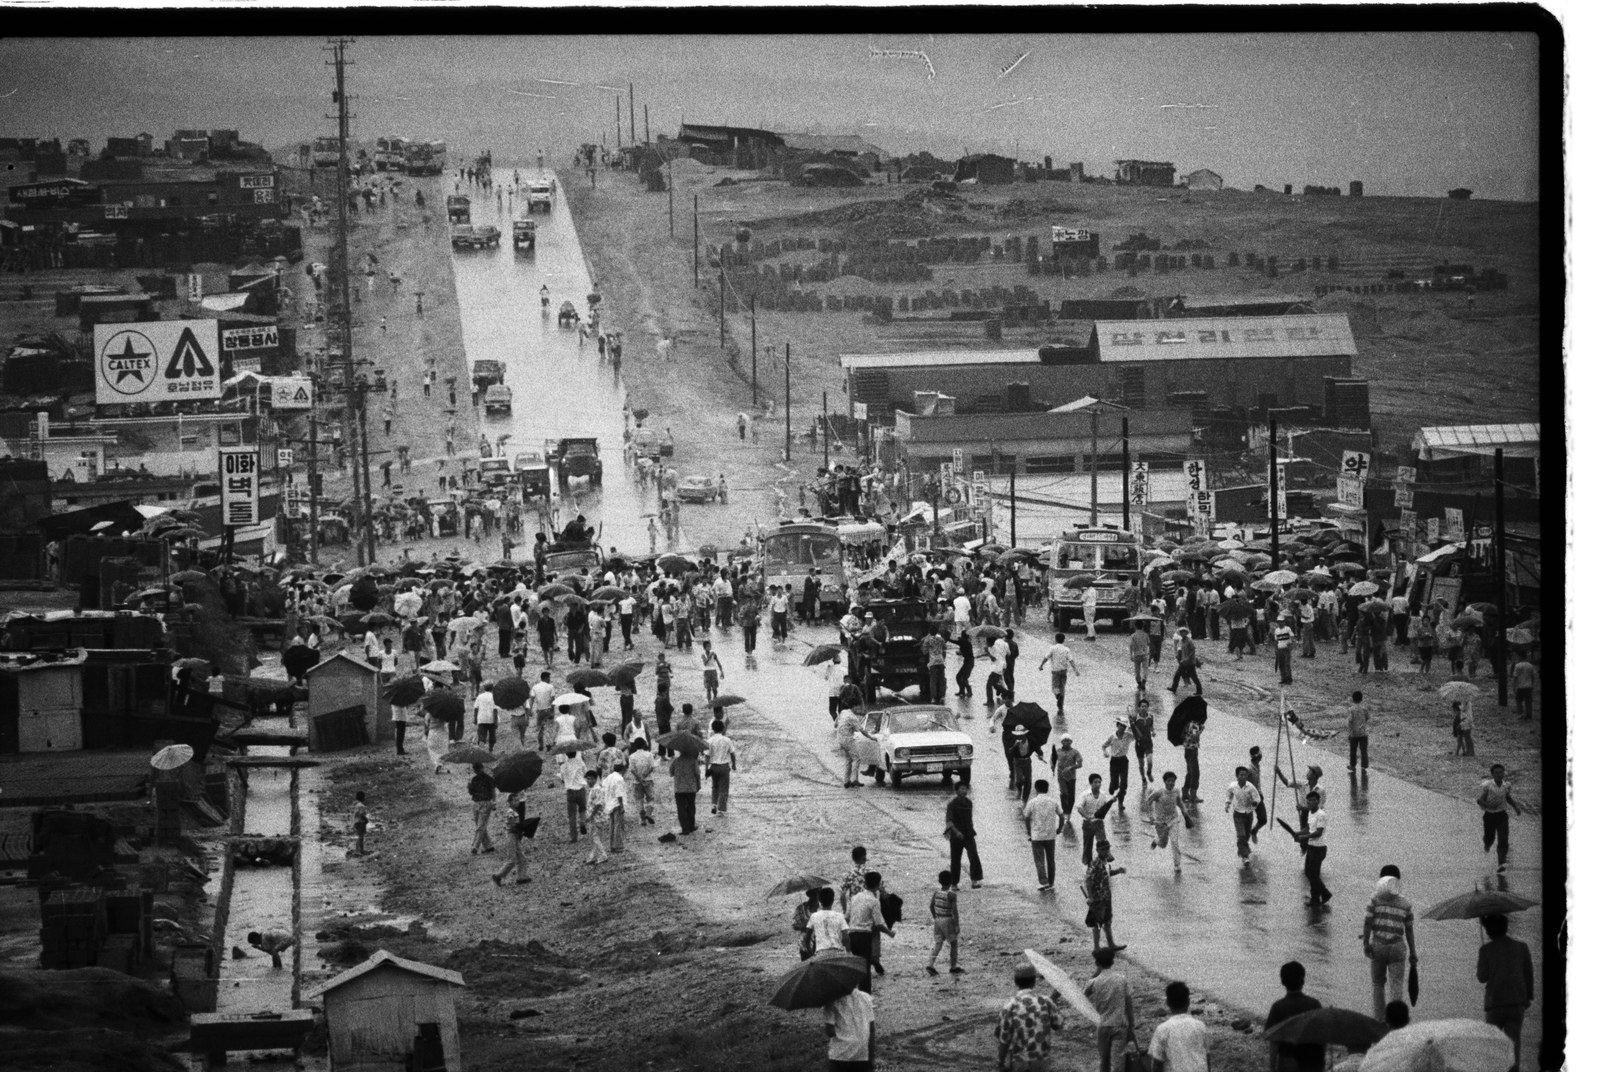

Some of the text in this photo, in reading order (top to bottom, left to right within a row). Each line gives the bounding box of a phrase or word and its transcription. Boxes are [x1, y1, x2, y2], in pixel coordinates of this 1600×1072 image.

[108, 358, 151, 371] CALTEX
[167, 380, 214, 394] 호남정유
[226, 454, 256, 475] 이화
[1344, 453, 1367, 475] 약
[227, 477, 254, 523] 벽돌
